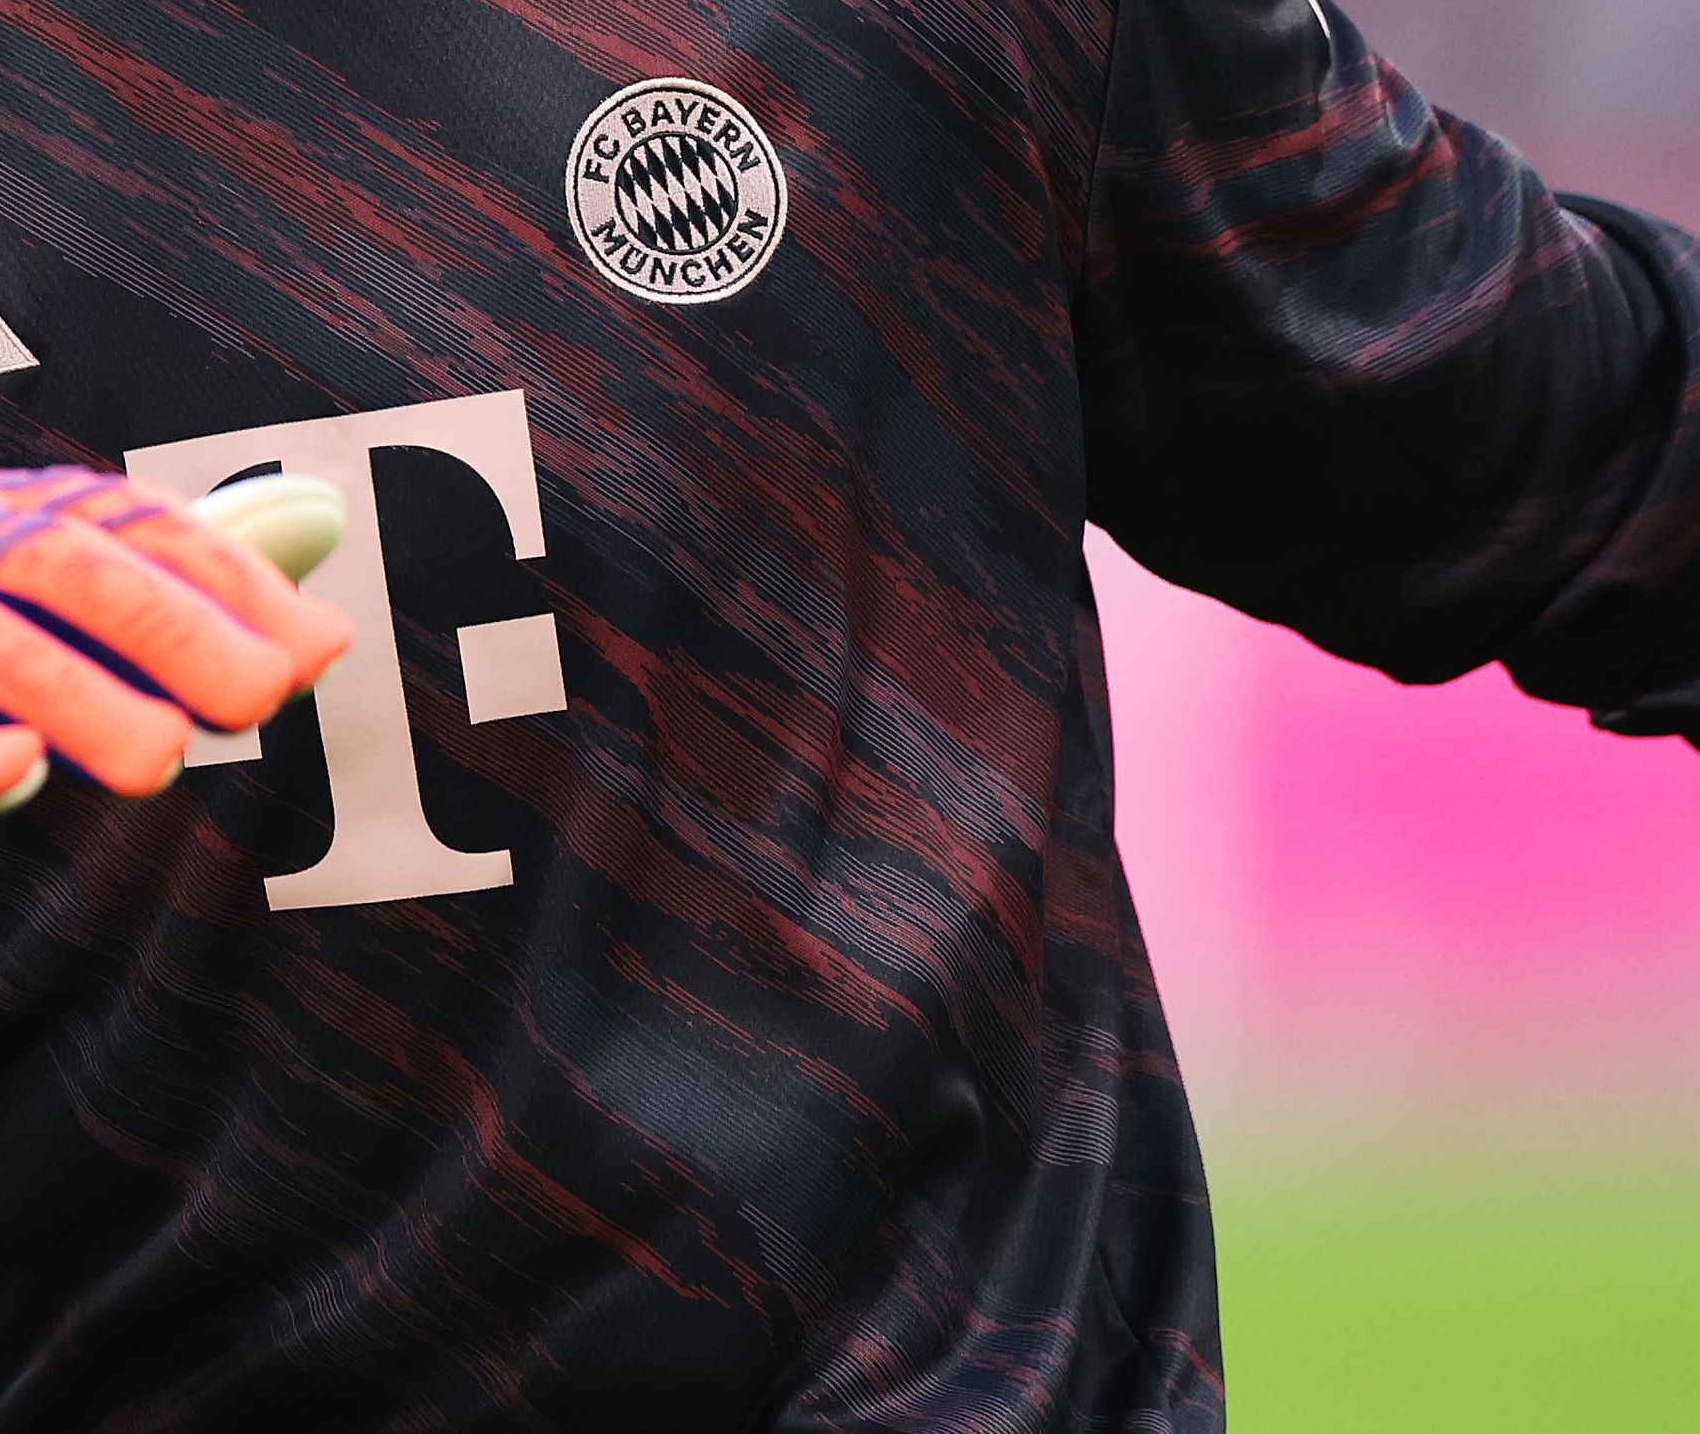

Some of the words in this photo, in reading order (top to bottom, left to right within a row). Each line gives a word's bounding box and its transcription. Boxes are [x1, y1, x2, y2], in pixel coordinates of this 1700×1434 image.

[582, 133, 621, 184] FC
[621, 97, 761, 172] BAYERN
[591, 208, 769, 287] MÜNCHEN
[124, 389, 567, 911] T
